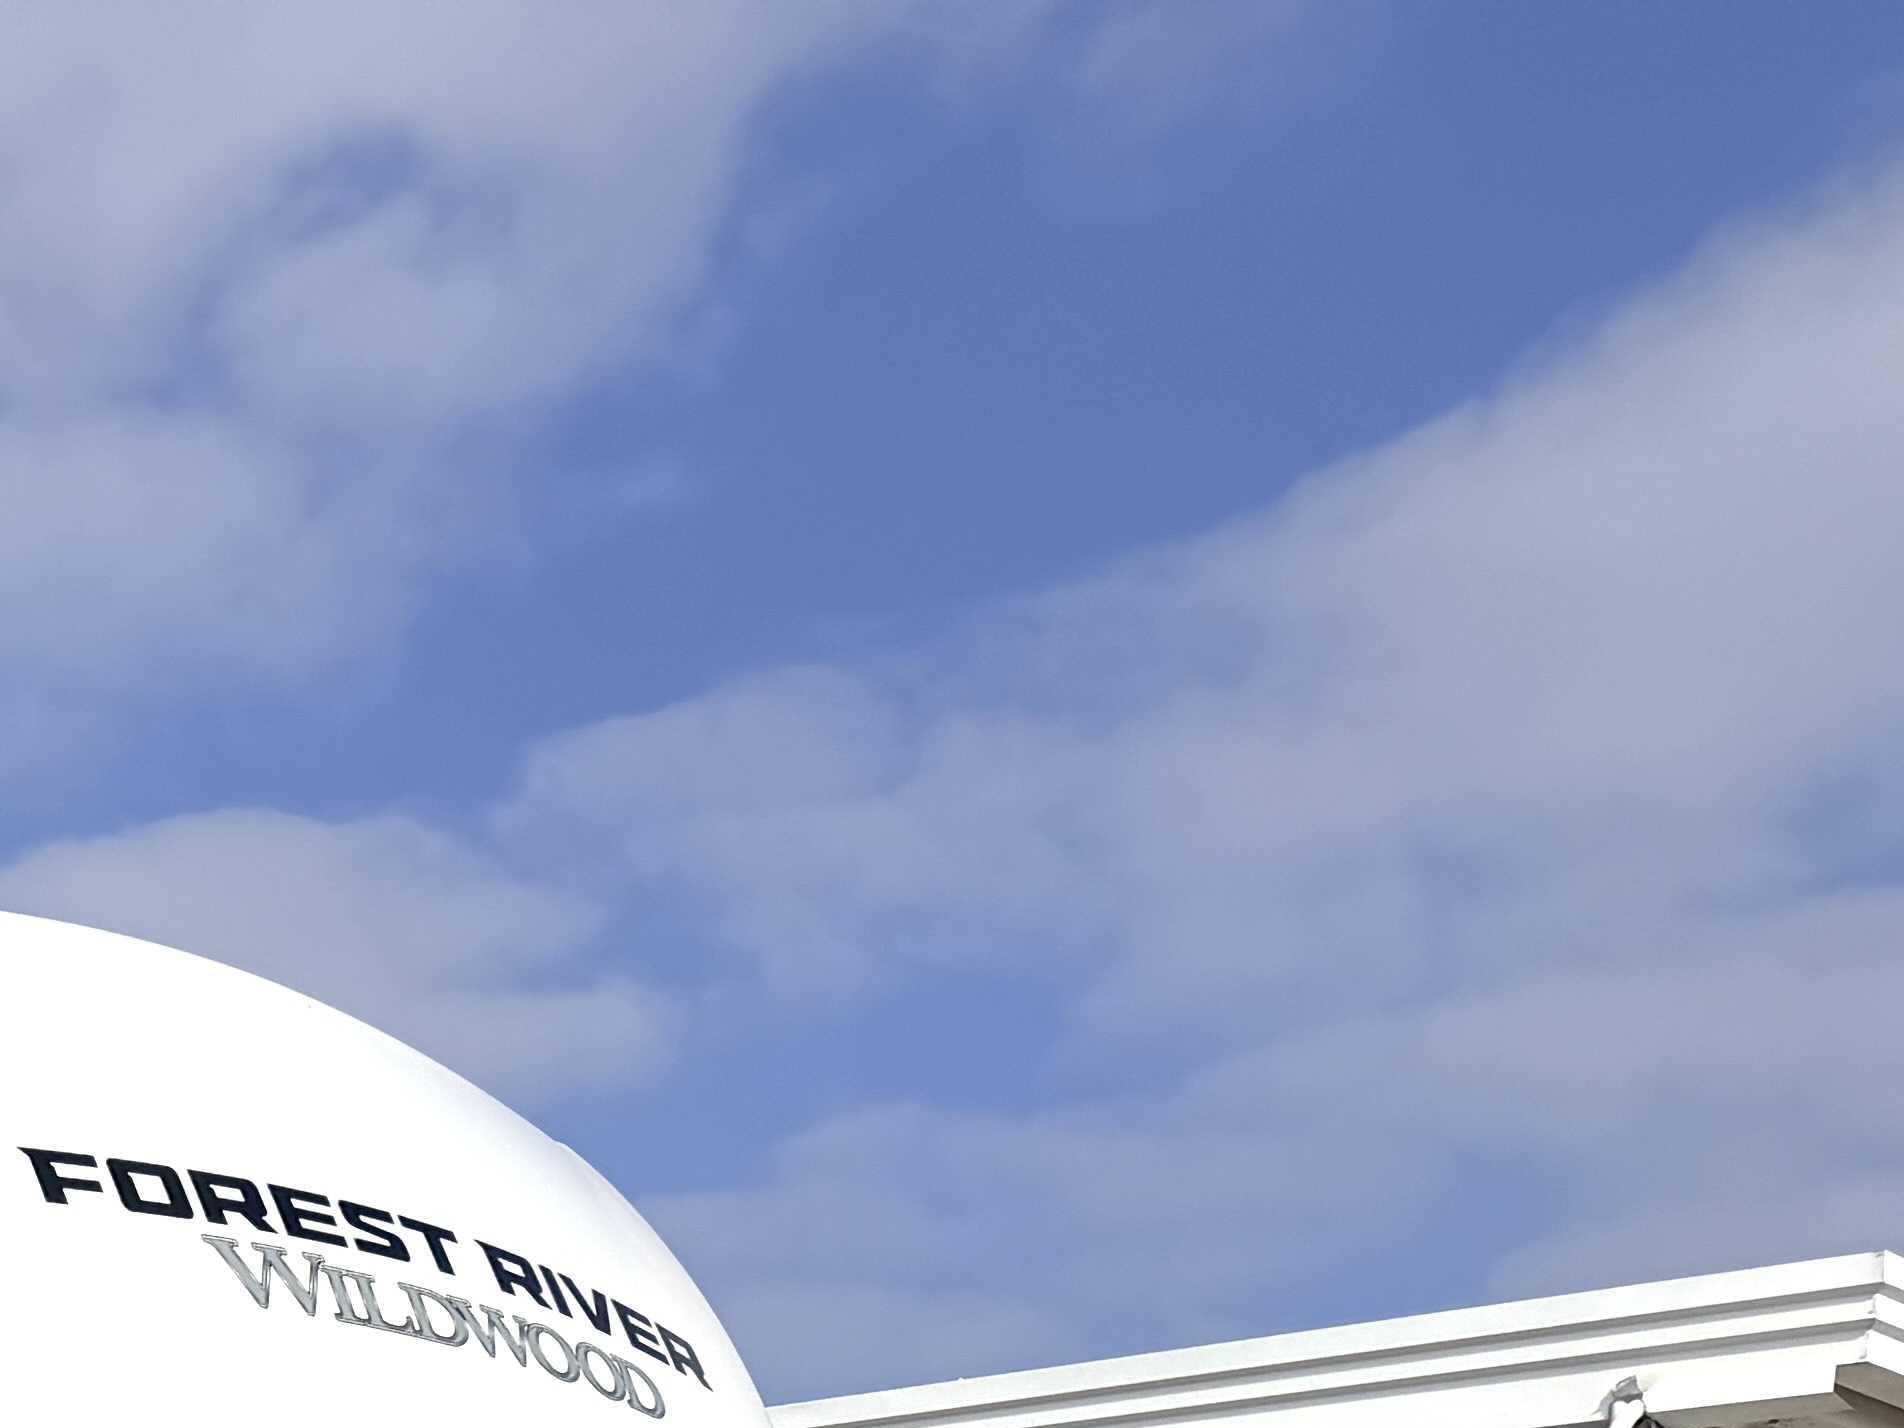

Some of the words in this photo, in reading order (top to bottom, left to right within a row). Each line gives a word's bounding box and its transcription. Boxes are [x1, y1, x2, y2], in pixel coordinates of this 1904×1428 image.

[17, 1146, 457, 1275] FOREST
[473, 1238, 714, 1392] RIVER
[201, 1234, 665, 1420] WILDWOOD
